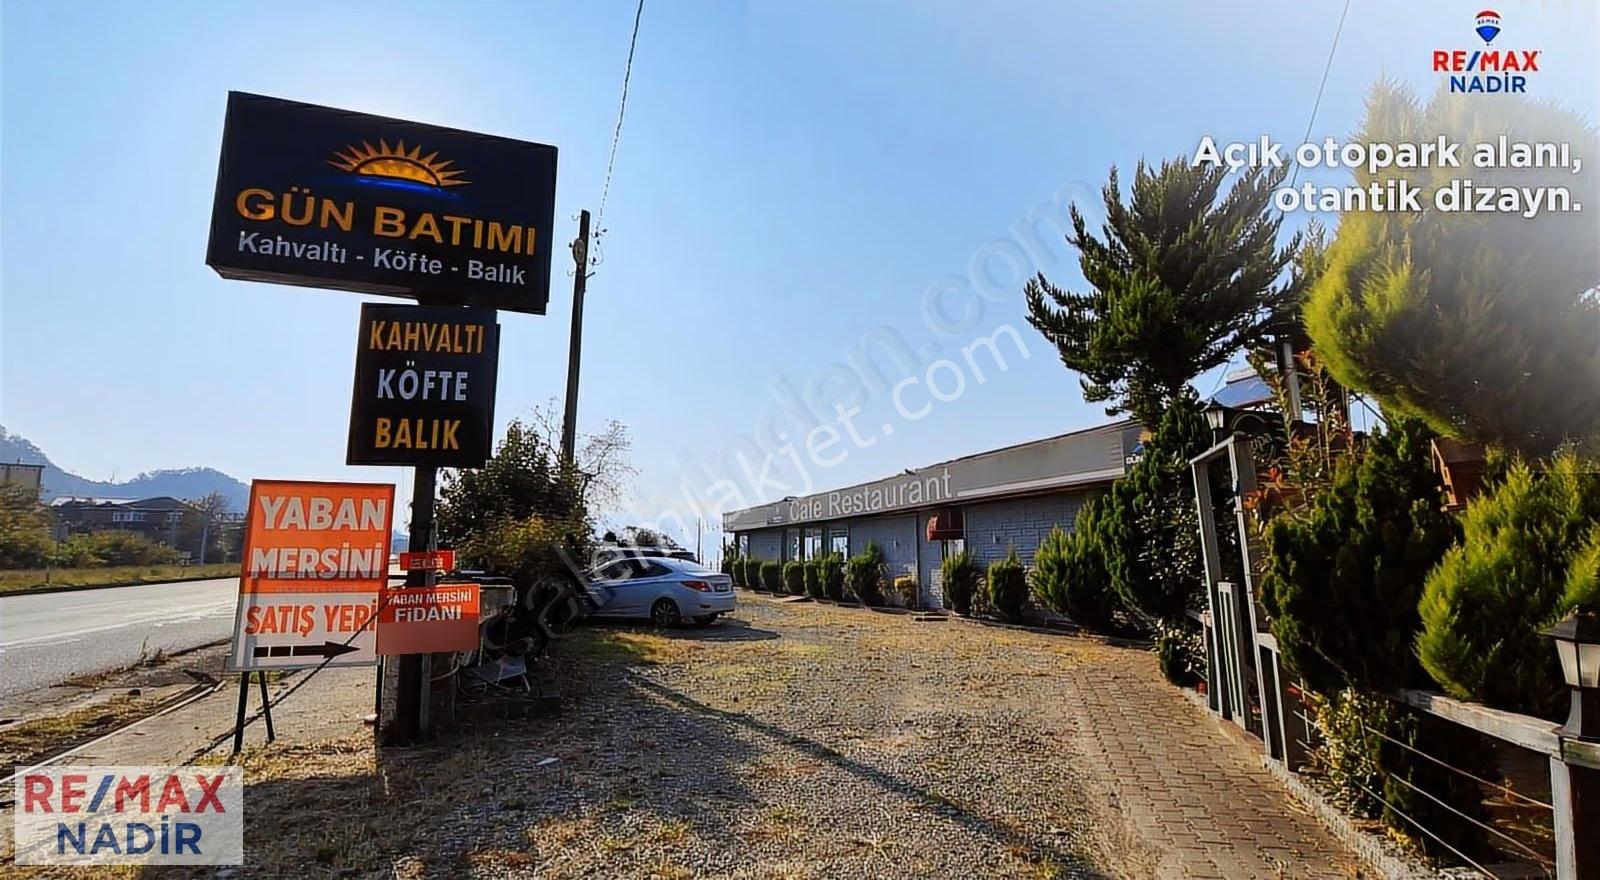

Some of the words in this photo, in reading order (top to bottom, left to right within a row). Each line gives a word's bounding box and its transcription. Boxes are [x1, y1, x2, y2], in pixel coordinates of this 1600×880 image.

[235, 186, 355, 232] GÜN
[373, 206, 537, 256] BATIMI
[238, 230, 347, 264] Kahvaltı
[373, 246, 442, 275] Köfte
[468, 259, 526, 286] Balık
[369, 320, 484, 354] KAHVALTI
[377, 360, 468, 401] KÖFTE
[374, 417, 462, 450] BALIK
[828, 467, 951, 517] Restaurant
[260, 495, 386, 531] YABAN
[250, 542, 383, 580] MERSİNİ
[244, 604, 316, 638] SATIŞ
[323, 598, 377, 633] YERİ
